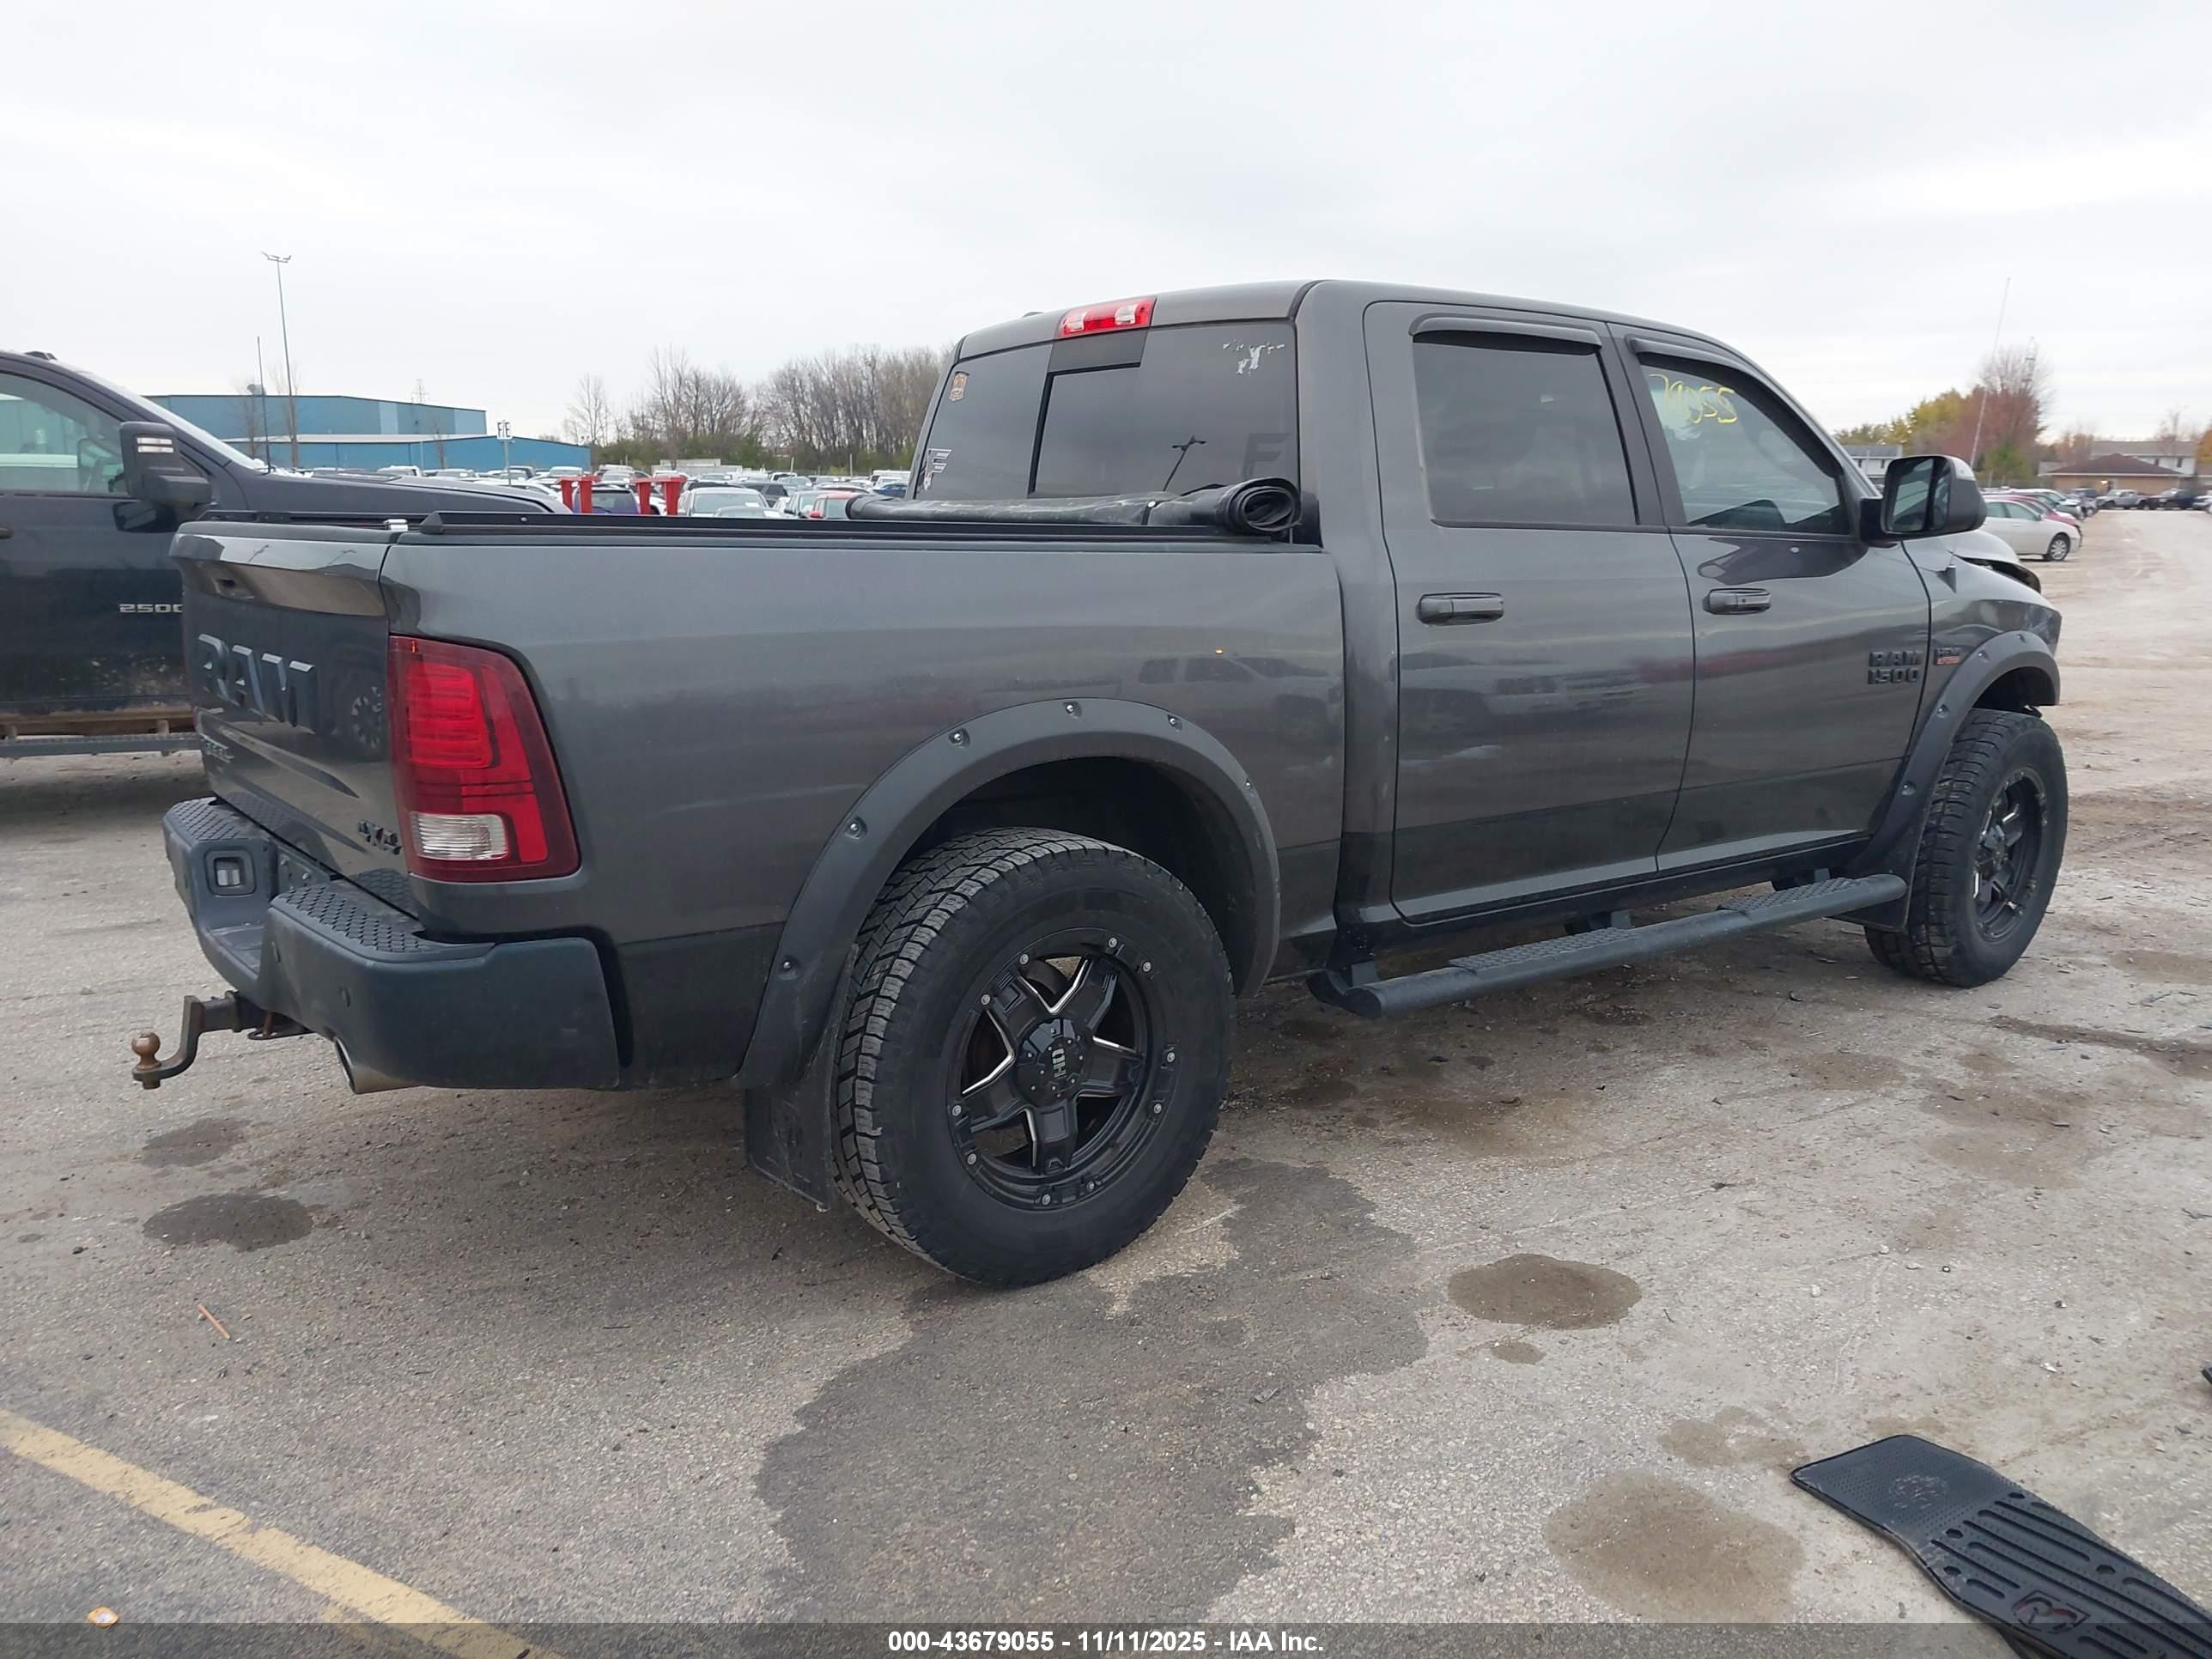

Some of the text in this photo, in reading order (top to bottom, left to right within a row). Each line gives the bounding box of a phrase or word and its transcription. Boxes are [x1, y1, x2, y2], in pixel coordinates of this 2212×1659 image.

[1869, 651, 1923, 666] RAM
[198, 633, 318, 735] RAM
[1868, 669, 1919, 684] 1500
